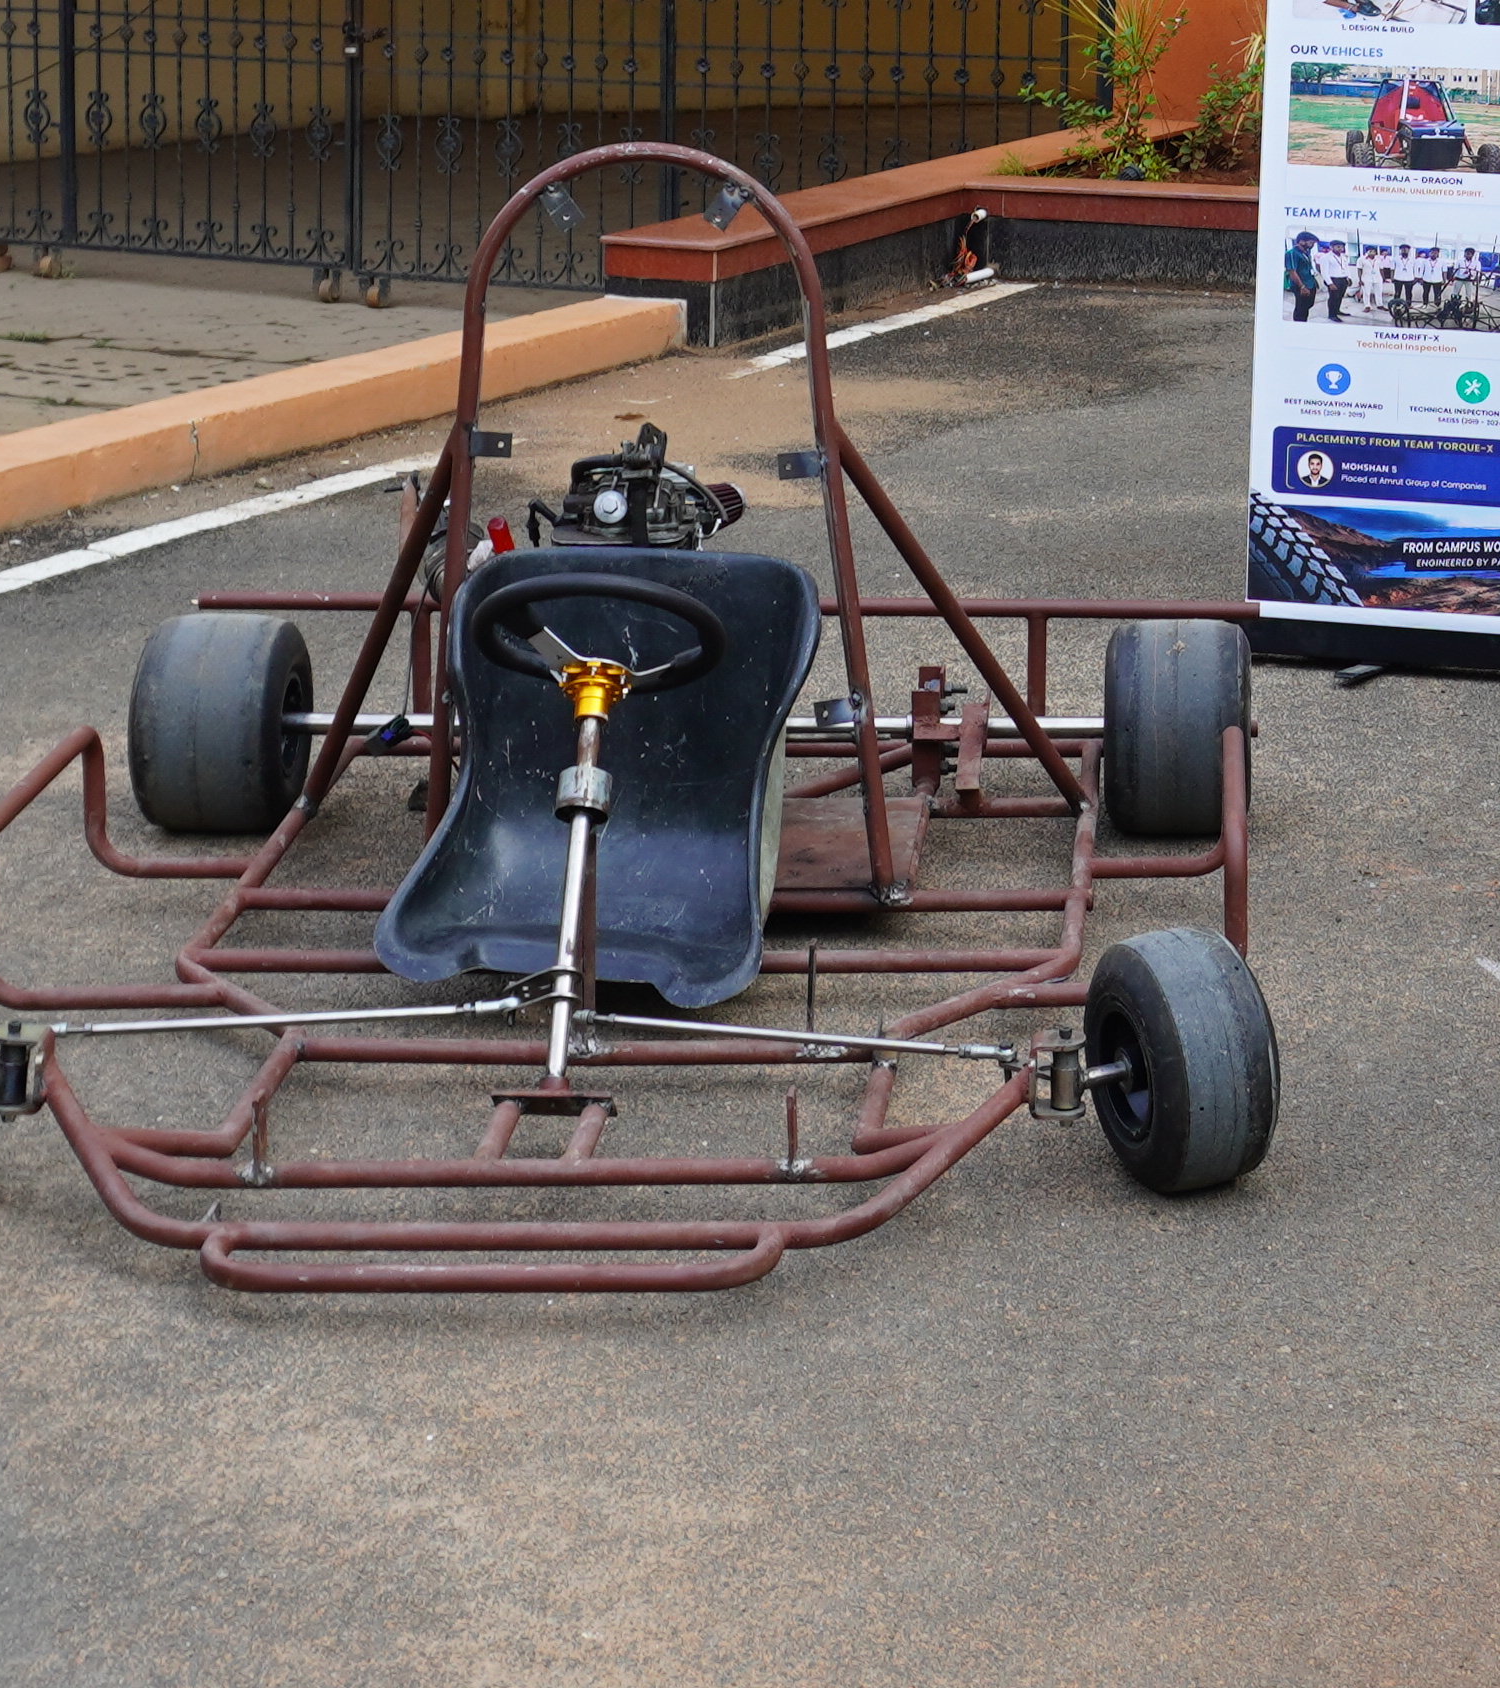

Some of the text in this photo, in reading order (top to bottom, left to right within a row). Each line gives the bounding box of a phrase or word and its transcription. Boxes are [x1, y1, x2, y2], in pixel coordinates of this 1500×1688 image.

[1348, 24, 1380, 33] DESIGN
[1390, 26, 1415, 34] BUILD
[1290, 44, 1384, 58] OUR VEHICLES
[1421, 176, 1463, 186] DRAGON
[1284, 207, 1378, 222] TEAM DRIFT-X
[1374, 332, 1440, 342] TEAM DRIFT-X
[1357, 340, 1457, 353] Technical Inspection
[1303, 399, 1353, 408] INNOVATION
[1354, 402, 1384, 410] AWARD
[1409, 405, 1453, 414] TECHNICAL
[1454, 407, 1500, 417] INSPECTION
[1296, 432, 1494, 453] PLACEMENTS FROM TEAM TORQUE-X
[1341, 474, 1368, 483] Placed
[1405, 478, 1430, 488] Group
[1431, 480, 1440, 488] of
[1441, 480, 1487, 492] Companies
[1402, 541, 1434, 554] FROM
[1435, 541, 1481, 553] CAMPUS
[1416, 558, 1474, 568] ENGINEERED
[1476, 558, 1489, 567] BY
